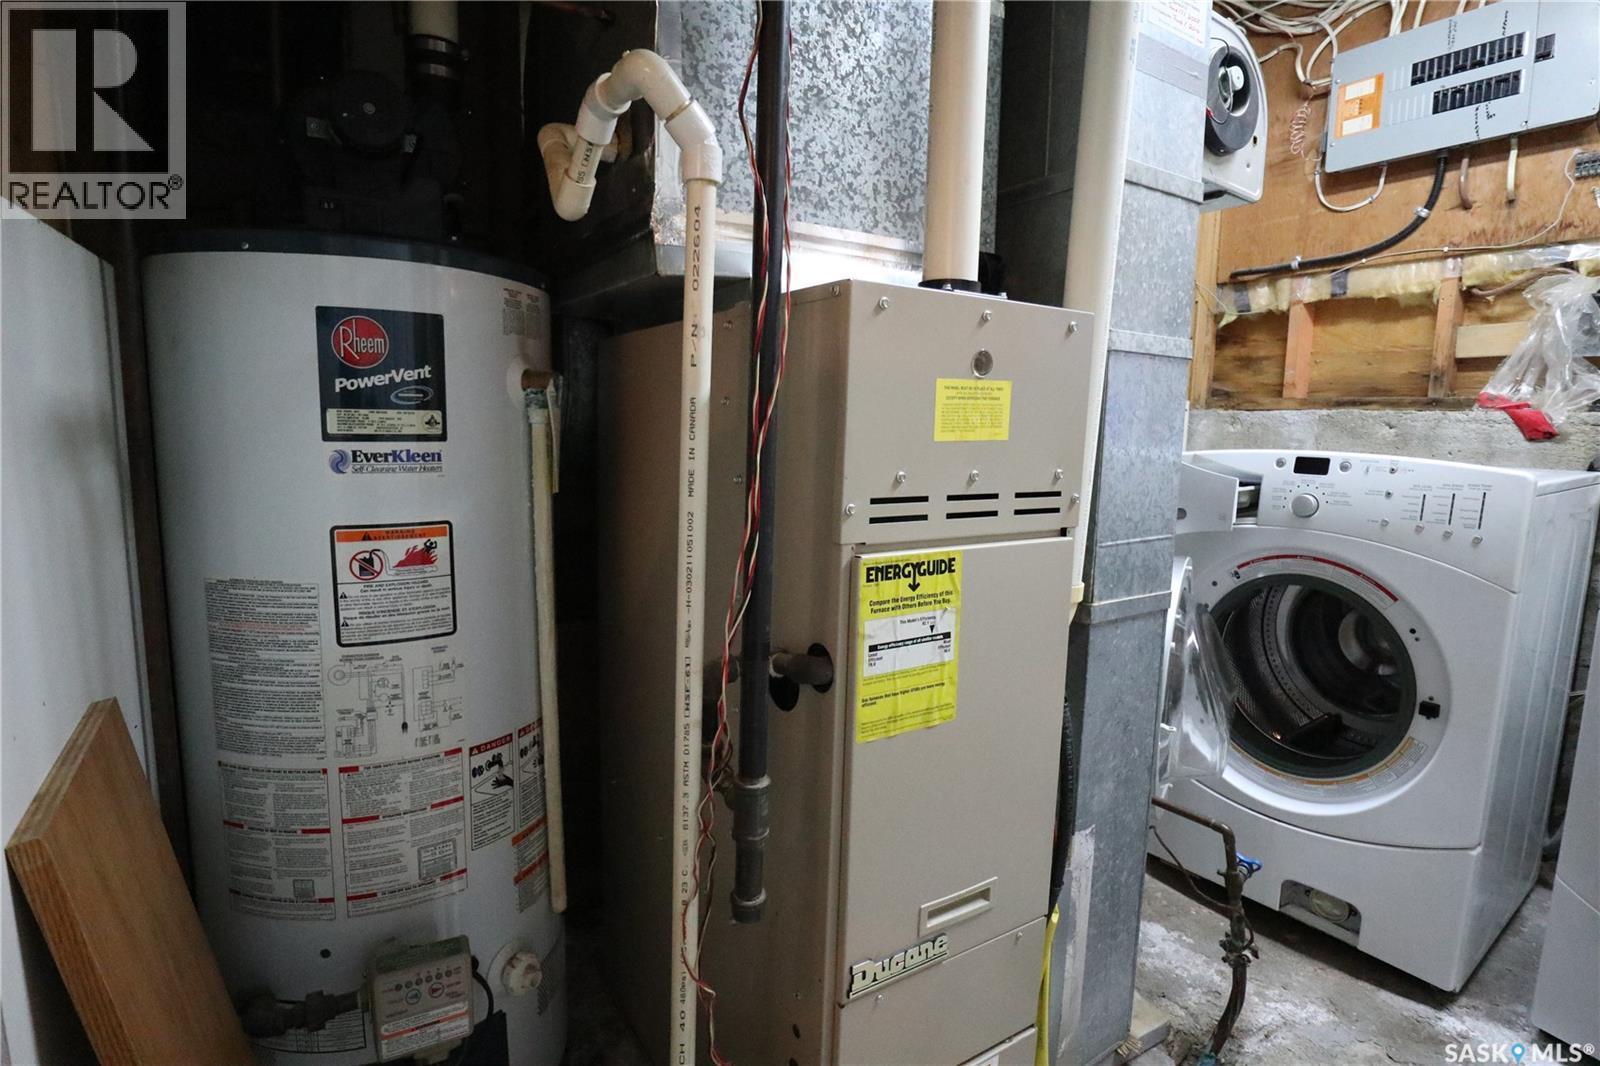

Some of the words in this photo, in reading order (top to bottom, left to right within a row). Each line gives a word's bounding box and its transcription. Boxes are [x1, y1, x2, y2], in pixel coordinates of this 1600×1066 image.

[692, 206, 701, 291] 022604
[339, 319, 385, 359] Rheem
[335, 364, 432, 393] PowerVent
[688, 397, 697, 441] CANADA
[688, 447, 696, 460] IN
[687, 469, 695, 497] MADE
[866, 557, 956, 585] ENERGYGUIDE
[869, 598, 890, 607] Compare
[916, 592, 938, 600] Efficiency
[870, 606, 890, 614] Furnace
[850, 934, 948, 992] Ducane
[679, 1010, 686, 1032] 40
